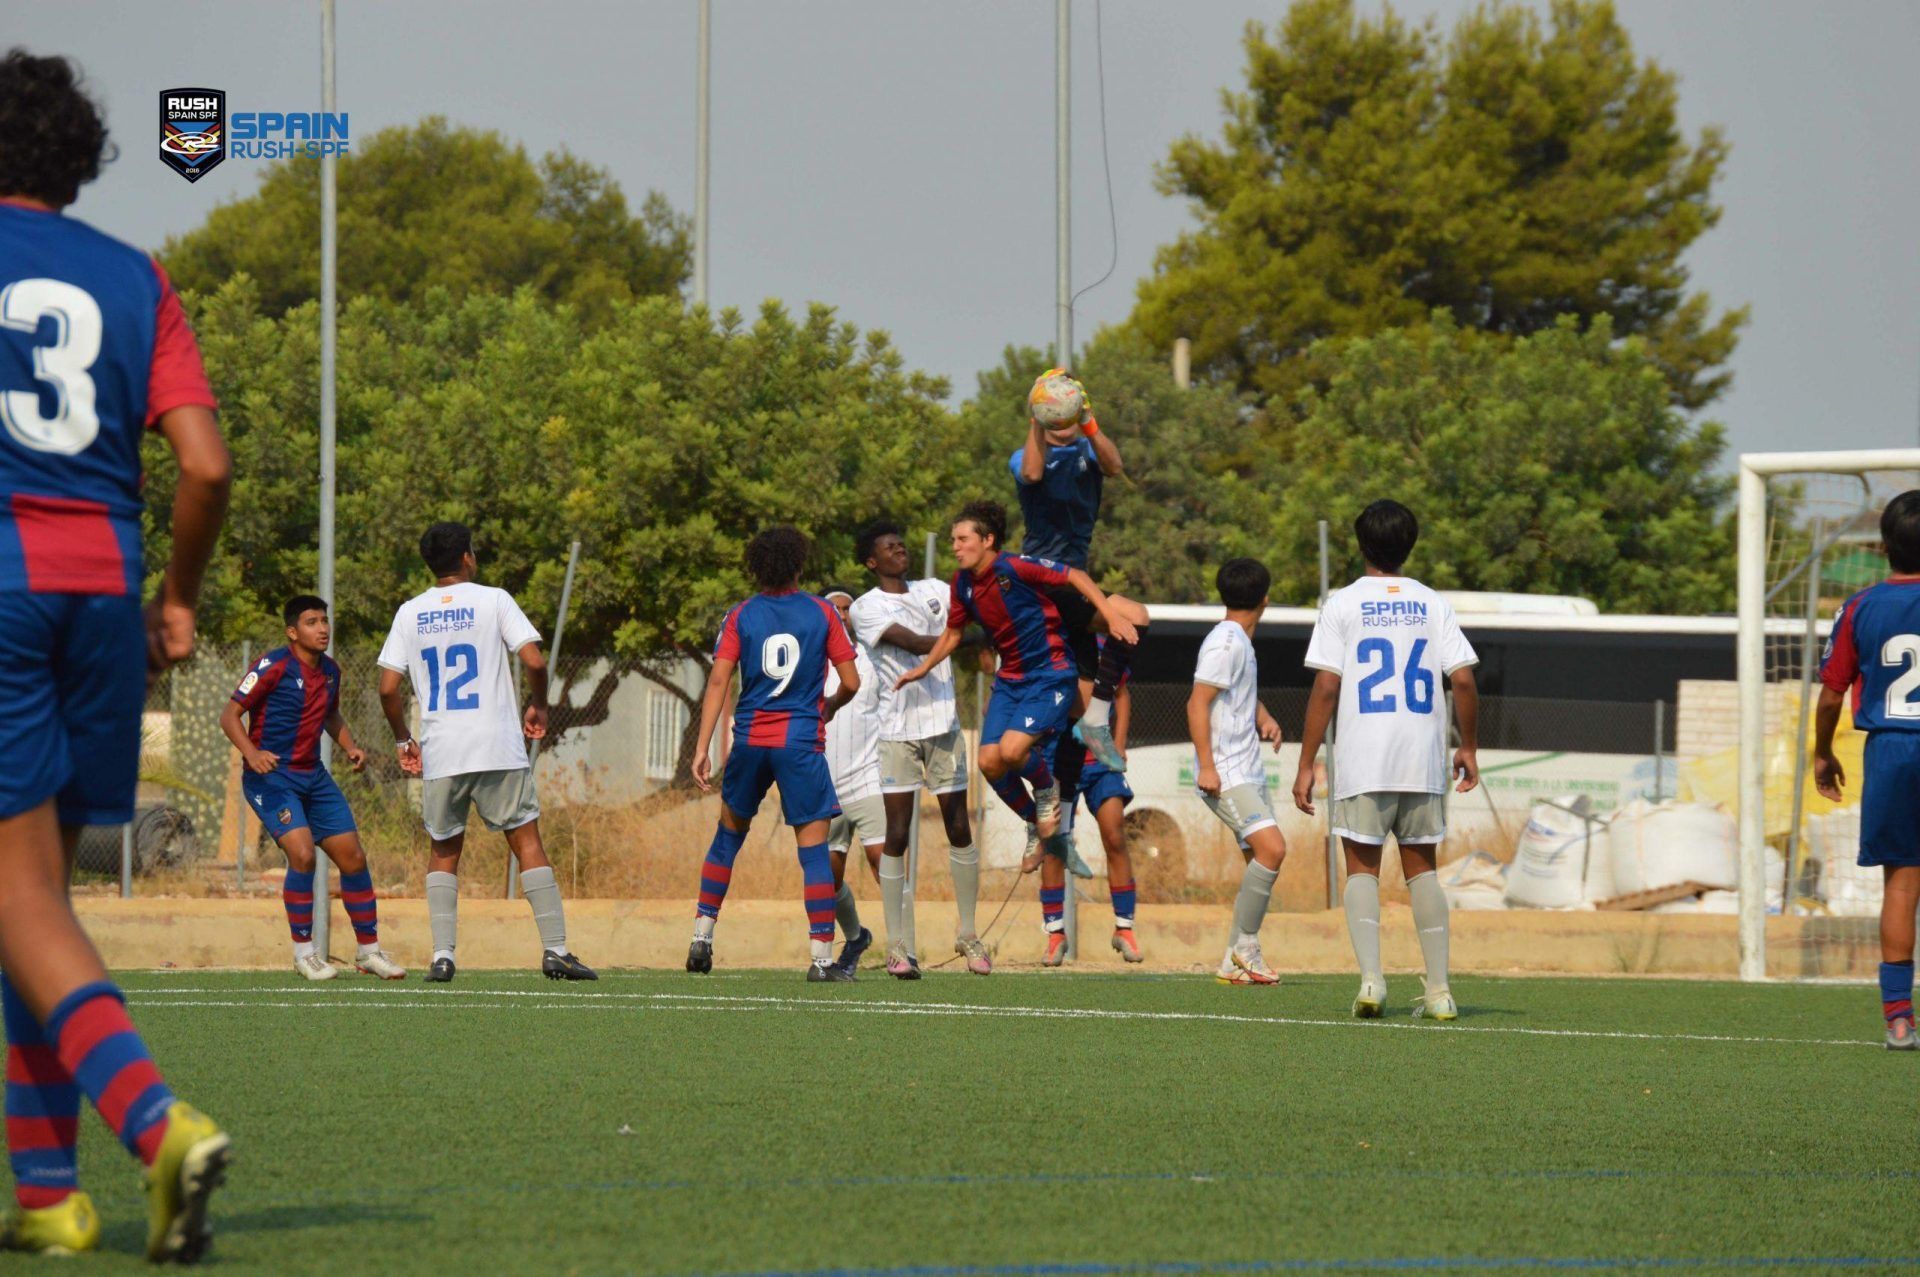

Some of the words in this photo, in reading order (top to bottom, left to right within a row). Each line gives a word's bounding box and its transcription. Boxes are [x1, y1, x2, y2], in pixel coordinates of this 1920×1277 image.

[0, 278, 102, 456] 3
[417, 607, 474, 626] SPAIN
[417, 621, 475, 635] RUSH-SPF
[1361, 601, 1427, 616] SPAIN
[1362, 616, 1427, 627] RUSH-SPF
[421, 643, 479, 712] 12
[762, 633, 801, 698] 9
[1357, 637, 1434, 714] 26
